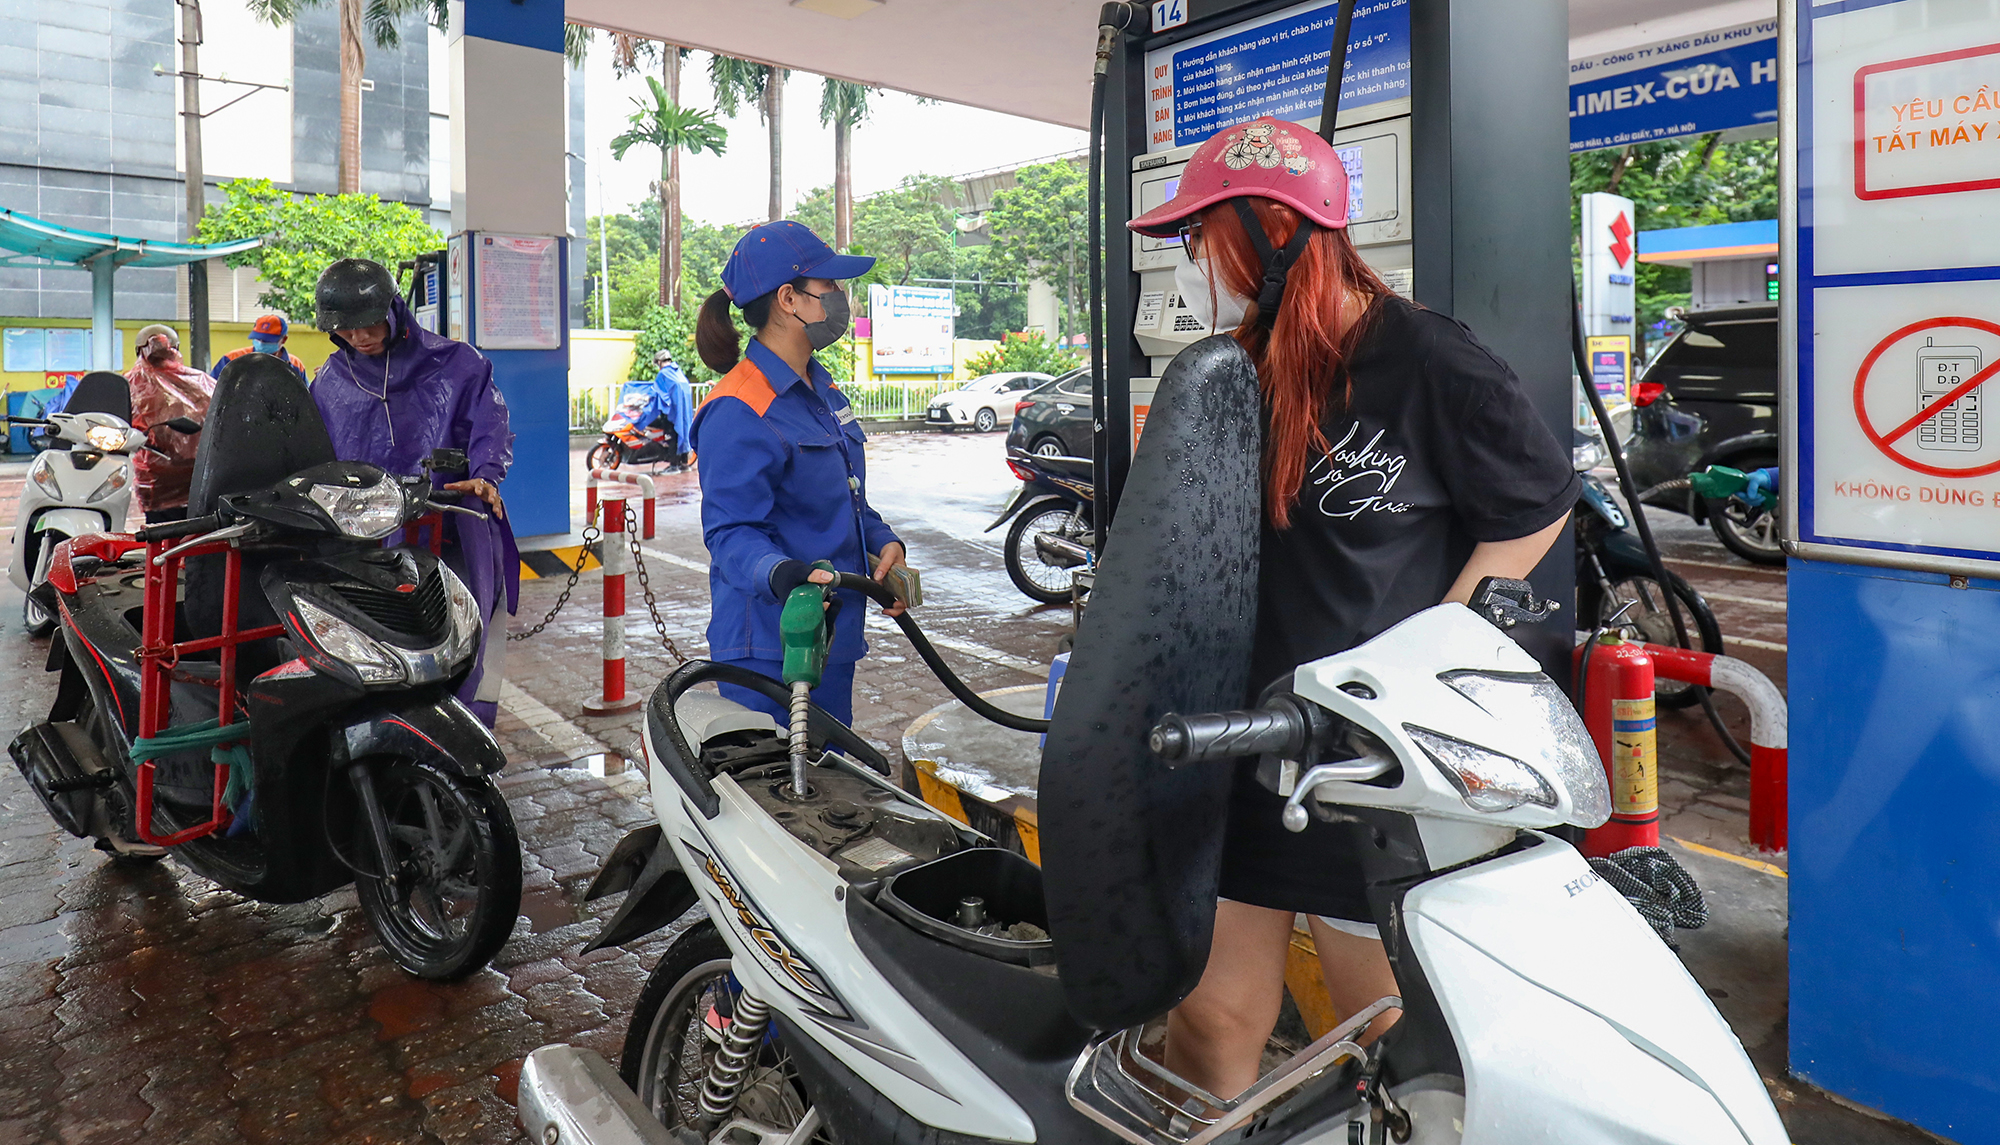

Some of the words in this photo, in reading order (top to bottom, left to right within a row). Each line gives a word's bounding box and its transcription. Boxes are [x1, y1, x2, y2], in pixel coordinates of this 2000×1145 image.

[1158, 0, 1181, 26] 14
[1218, 46, 1238, 58] khách
[1239, 41, 1256, 51] hàng
[1258, 36, 1270, 46] vào
[1272, 33, 1278, 43] vị
[1291, 25, 1309, 37] chào
[1311, 20, 1323, 30] hỏi
[1324, 17, 1334, 26] và
[1373, 2, 1390, 12] nhu
[1603, 53, 1634, 66] CÔNG
[1638, 48, 1653, 58] TY
[1724, 28, 1752, 40] KHU
[1155, 64, 1168, 80] QUY
[1183, 73, 1194, 82] của
[1195, 68, 1214, 78] khách
[1215, 63, 1233, 73] hàng.
[1184, 86, 1195, 95] Mời
[1196, 81, 1215, 92] khách
[1216, 76, 1232, 86] hàng
[1234, 72, 1245, 82] xác
[1247, 68, 1264, 78] nhận
[1265, 63, 1280, 73] màn
[1282, 58, 1298, 68] hình
[1300, 54, 1312, 64] cột
[1313, 50, 1330, 60] bơm
[1354, 40, 1360, 49] ở
[1362, 35, 1372, 48] số
[1152, 84, 1172, 101] TRÌNH
[1184, 101, 1198, 109] Bơm
[1200, 96, 1215, 104] hàng
[1236, 86, 1245, 95] đủ
[1246, 84, 1261, 92] theo
[1263, 79, 1275, 90] yêu
[1277, 74, 1290, 84] cầu
[1292, 71, 1305, 81] của
[1307, 65, 1329, 77] khách
[1184, 113, 1195, 122] Mời
[1197, 109, 1216, 119] khách
[1217, 105, 1233, 114] hàng
[1234, 101, 1246, 110] xác
[1248, 97, 1264, 106] nhận
[1266, 93, 1281, 102] màn
[1283, 88, 1298, 98] hình
[1301, 84, 1312, 94] cột
[1358, 70, 1369, 80] khi
[1372, 64, 1395, 76] thanh
[1155, 106, 1170, 122] BÁN
[1185, 128, 1200, 136] Thực
[1202, 123, 1215, 132] hiện
[1216, 119, 1234, 128] thanh
[1236, 114, 1250, 123] toán
[1262, 109, 1274, 117] xác
[1276, 104, 1293, 115] nhận
[1295, 99, 1306, 109] kết
[1357, 83, 1381, 96] khách
[1384, 79, 1407, 90] hàng.
[1892, 98, 1943, 122] YÊU
[1153, 129, 1172, 144] HÀNG
[1654, 128, 1666, 136] TP.
[1668, 124, 1680, 134] HÀ
[1873, 125, 1921, 153] TẮT
[1930, 120, 1989, 147] MÁY
[1834, 478, 1911, 501] KHÔNG
[1920, 482, 1984, 507] DÙNG
